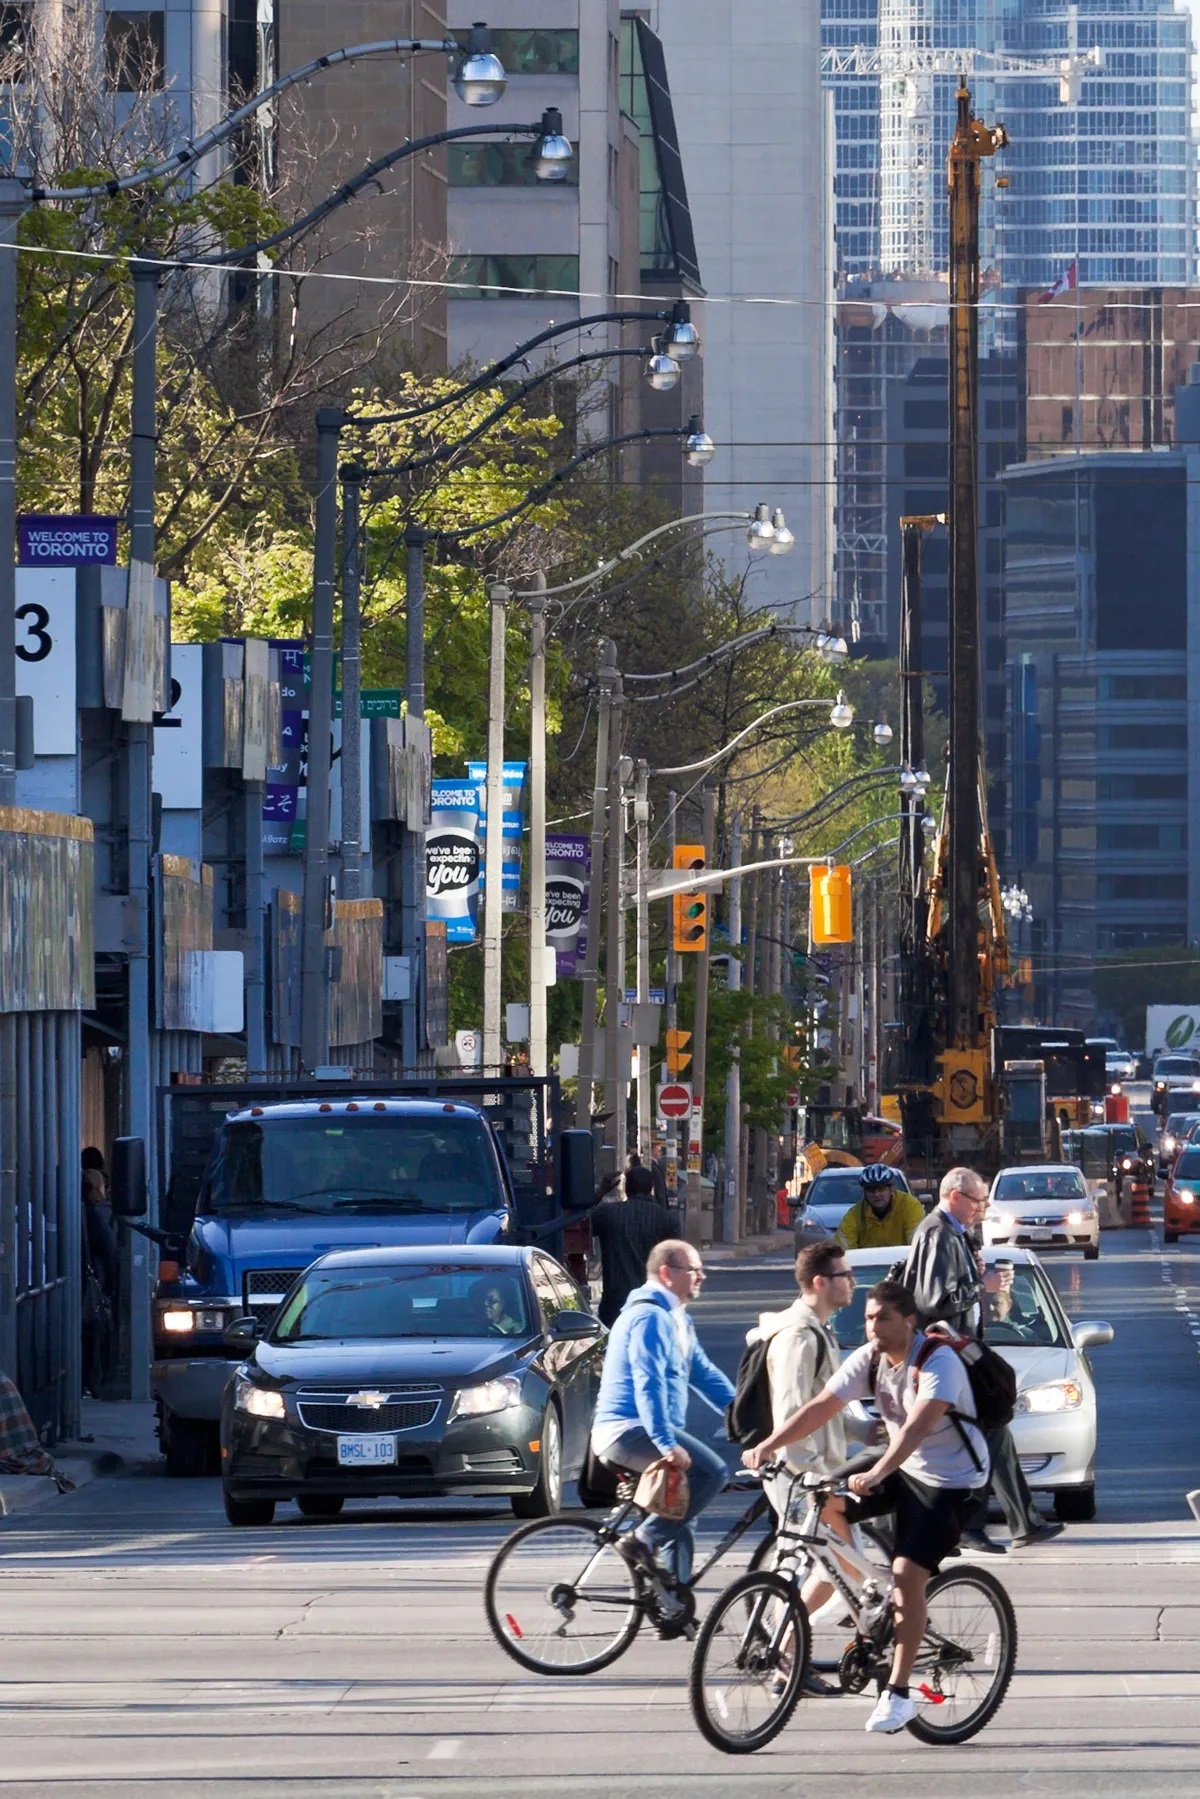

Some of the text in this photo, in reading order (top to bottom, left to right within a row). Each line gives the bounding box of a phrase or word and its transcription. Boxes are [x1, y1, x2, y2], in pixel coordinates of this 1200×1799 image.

[28, 531, 109, 542] WELCOME TO
[28, 542, 109, 557] TORONTO
[14, 603, 52, 663] 3
[432, 789, 464, 797] ELCOME
[431, 796, 476, 806] ORONTO
[452, 845, 476, 855] been
[545, 841, 574, 850] ELCOME
[545, 848, 584, 858] ORONTO
[429, 854, 476, 865] expecting
[428, 863, 470, 892] you
[562, 891, 582, 900] been
